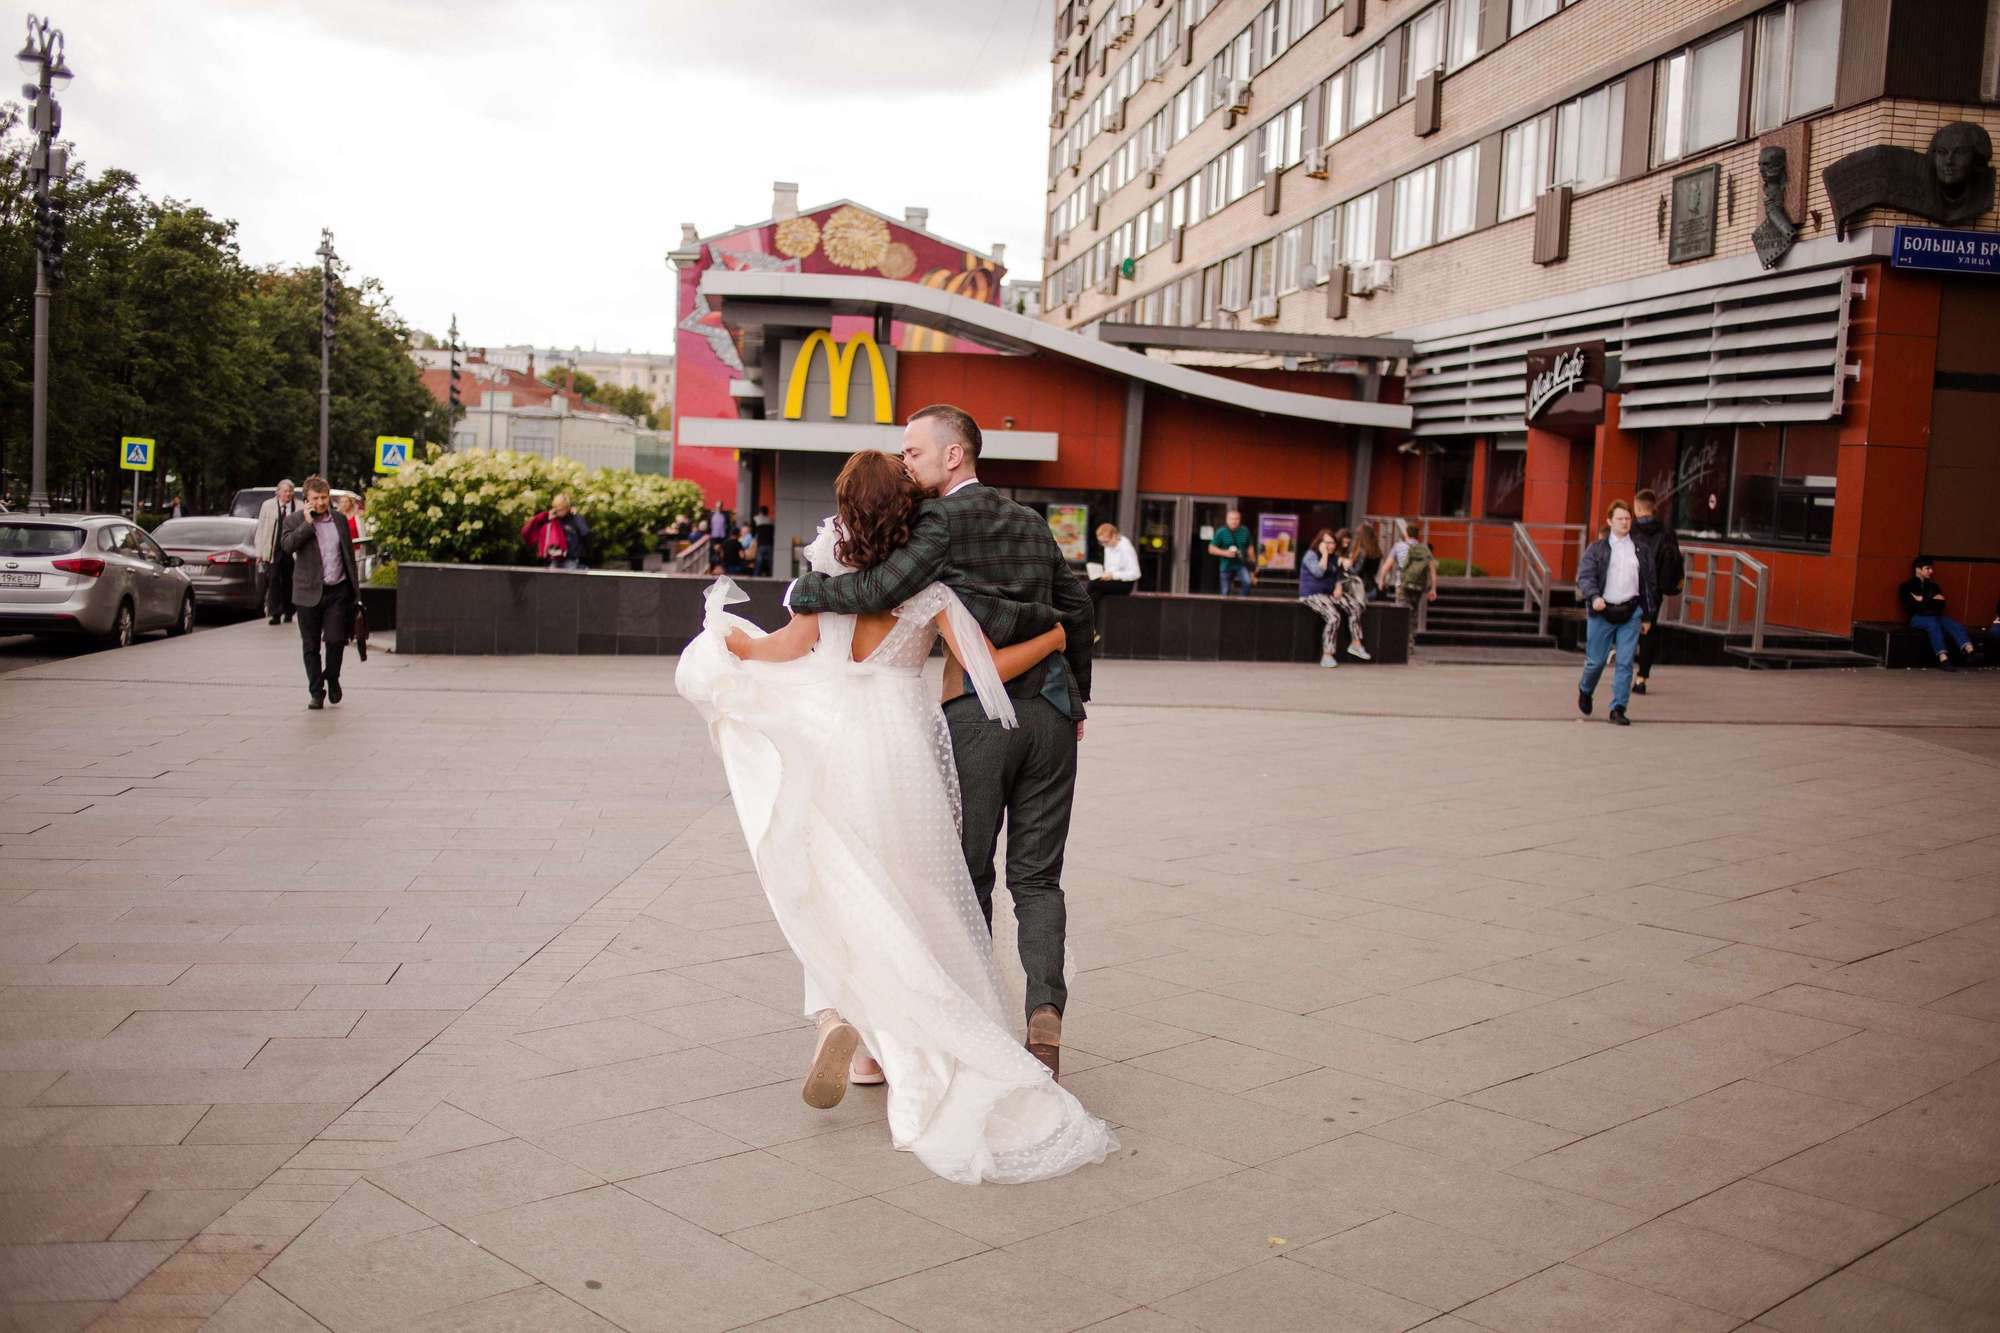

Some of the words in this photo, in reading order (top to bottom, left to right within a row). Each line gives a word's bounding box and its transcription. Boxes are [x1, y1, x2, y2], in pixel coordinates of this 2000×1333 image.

[1904, 236, 1975, 255] БОЛЬШАЯ
[1981, 242, 2000, 256] БР
[1958, 256, 1991, 266] УЛИЦА
